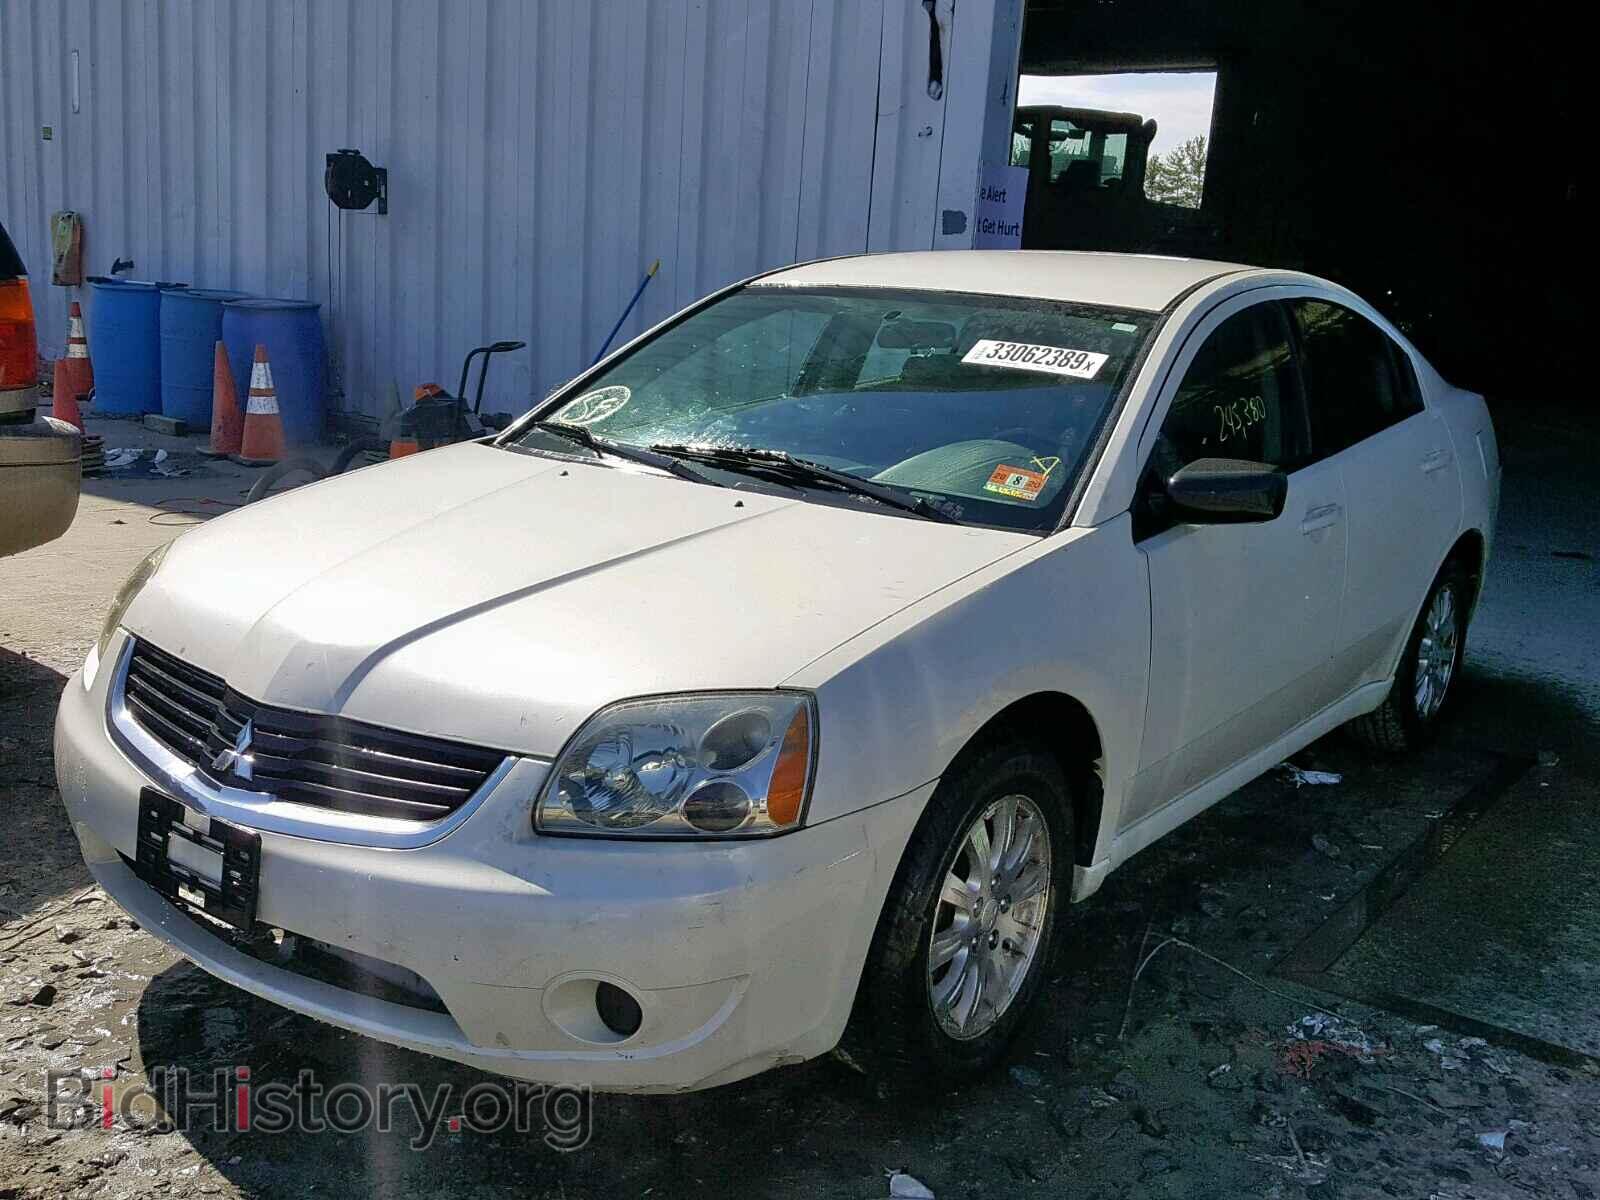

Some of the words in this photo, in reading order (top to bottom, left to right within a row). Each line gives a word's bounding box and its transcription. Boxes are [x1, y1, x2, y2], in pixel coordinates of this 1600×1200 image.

[986, 186, 1007, 203] Alert
[982, 218, 995, 234] Get
[997, 221, 1020, 236] Hurt
[1012, 475, 1023, 485] 8
